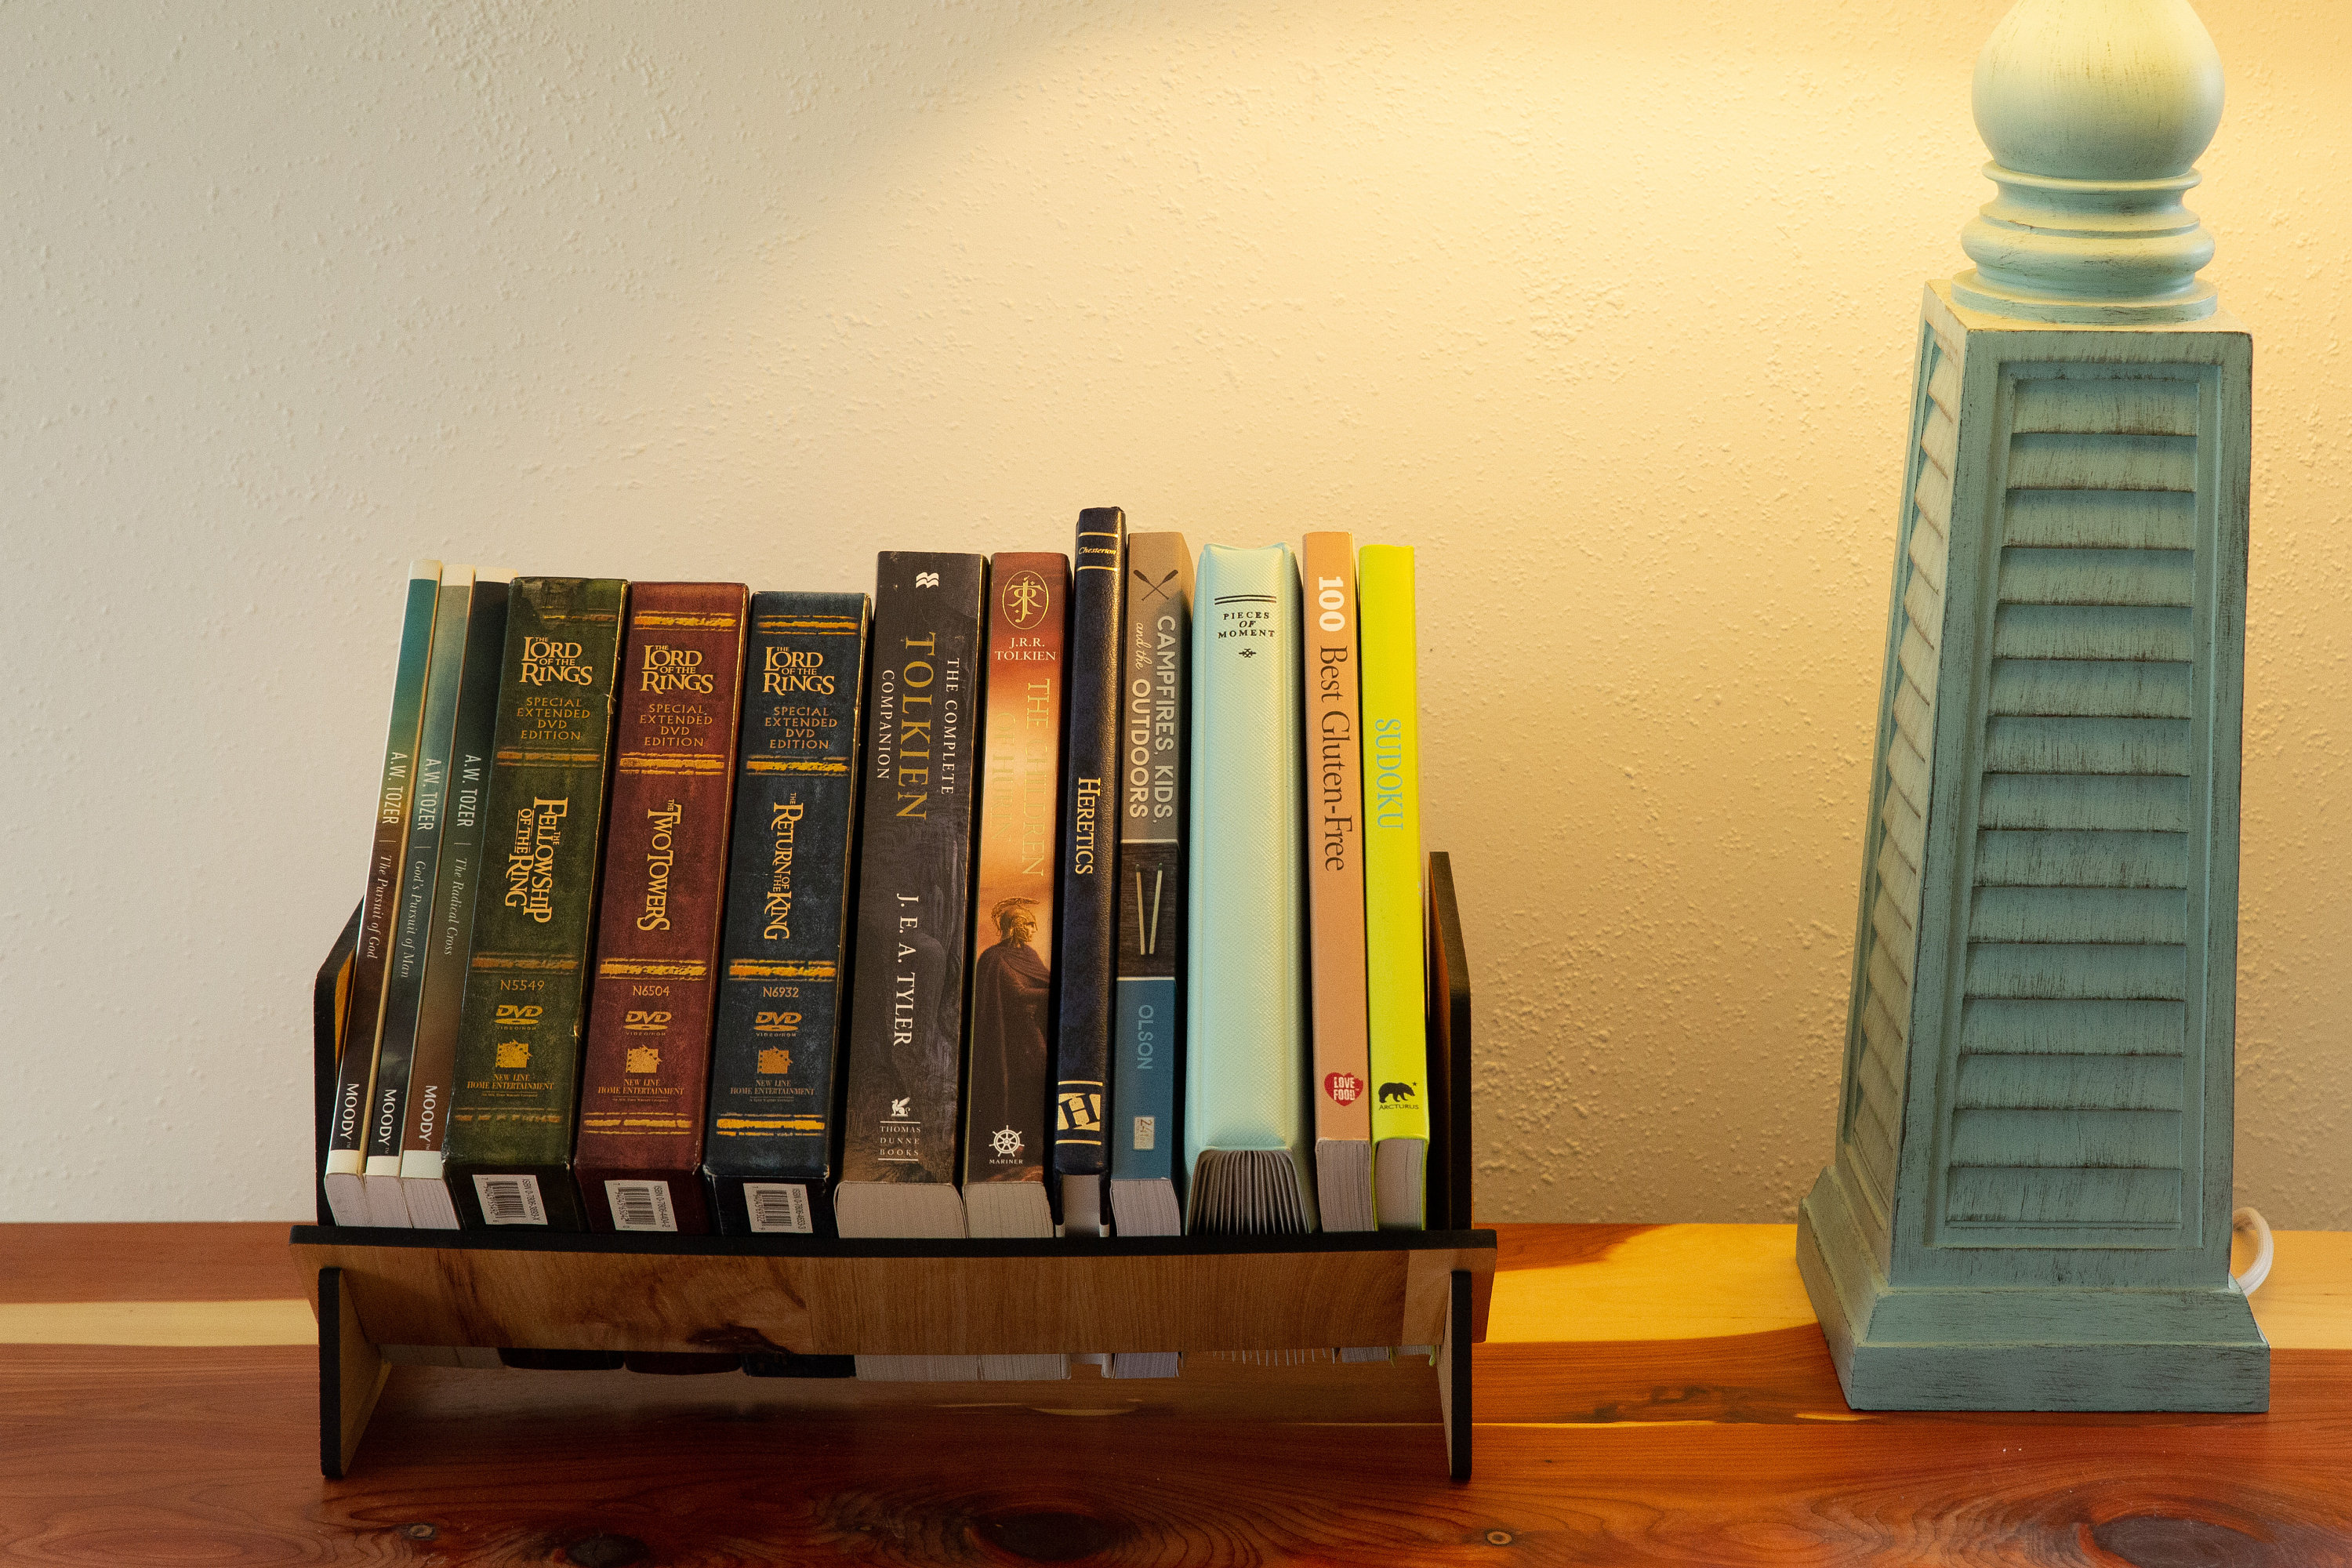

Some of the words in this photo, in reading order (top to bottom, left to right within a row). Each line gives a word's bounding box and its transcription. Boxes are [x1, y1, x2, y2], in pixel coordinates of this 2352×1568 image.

[1078, 546, 1116, 555] Chesterton
[1318, 575, 1345, 632] 100
[1223, 612, 1269, 620] PIECES
[1009, 637, 1045, 649] J.R.R.
[1135, 622, 1152, 650] and
[1218, 629, 1276, 639] MOMENT
[521, 637, 583, 662] LORD
[641, 644, 702, 670] LORD
[763, 646, 823, 671] LORD
[994, 651, 1056, 661] TOLKIEN
[1135, 648, 1152, 670] the
[518, 662, 593, 686] RINGS
[640, 671, 713, 695] RINGS
[761, 672, 835, 696] RINGS
[946, 658, 960, 692] THE
[1153, 615, 1176, 756] CAMPFIRES,
[1319, 644, 1348, 703] Best
[517, 708, 590, 719] EXTENDED
[526, 697, 583, 707] SPECIAL
[649, 703, 705, 714] SPECIAL
[774, 706, 829, 717] SPECIAL
[1026, 678, 1051, 729] THE
[538, 719, 567, 729] DVD
[640, 714, 713, 725] EXTENDED
[661, 726, 690, 735] DVD
[764, 717, 837, 728] EXTENDED
[877, 670, 895, 779] COMPANION
[895, 631, 937, 821] TOLKIEN
[993, 712, 1016, 746] OF
[521, 730, 581, 741] EDITION
[644, 736, 704, 746] EDITION
[769, 739, 829, 750] EDITION
[786, 728, 815, 738] DVD
[941, 699, 958, 795] COMPLETE
[1129, 678, 1151, 819] OUTDOORS
[387, 752, 408, 781] A.W.
[422, 758, 442, 787] A.W.
[462, 754, 481, 783] A.W.
[1374, 718, 1404, 830] SUDOKU
[1152, 764, 1174, 823] KIDS,
[1321, 710, 1352, 872] Gluten-Free
[382, 786, 404, 824] TOZER
[416, 792, 438, 831] TOZER
[456, 789, 478, 827] TOZER
[520, 808, 532, 826] OF
[1022, 739, 1047, 877] CHILDREN
[553, 831, 561, 845] THE
[647, 804, 681, 851] TWO
[771, 802, 804, 875] RETURN
[1075, 778, 1101, 875] HERETICS
[517, 828, 531, 854] THE
[379, 855, 392, 875] The
[453, 858, 467, 878] The
[523, 797, 568, 924] FELLOWSHIP
[412, 860, 426, 891] God's
[505, 853, 535, 907] RING
[772, 874, 782, 892] THE
[782, 877, 789, 889] OF
[372, 878, 388, 919] Pursuit
[637, 850, 674, 931] TOWERS
[896, 893, 919, 907] J.
[407, 894, 423, 935] Pursuit
[448, 881, 464, 925] Radical
[764, 891, 792, 940] KING
[899, 916, 918, 934] E.
[366, 922, 381, 935] of
[366, 937, 380, 959] God
[401, 938, 415, 950] of
[444, 927, 458, 956] Cross
[898, 942, 916, 963] A.
[401, 952, 415, 978] Man
[500, 979, 545, 991] N5549
[632, 985, 670, 996] N6504
[763, 986, 799, 998] N6932
[495, 1004, 543, 1018] DVD
[625, 1011, 672, 1024] DVD
[755, 1011, 802, 1025] DVD
[893, 971, 916, 1047] TYLER
[1137, 1004, 1154, 1069] OLSON
[467, 1080, 490, 1089] HOME
[622, 1087, 684, 1095] ENTERTAINMENT
[1334, 1076, 1355, 1089] LOVE
[1333, 1089, 1356, 1101] FOOD
[340, 1083, 360, 1141] MOODY
[378, 1089, 397, 1146] MOODY
[419, 1085, 438, 1142] MOODY
